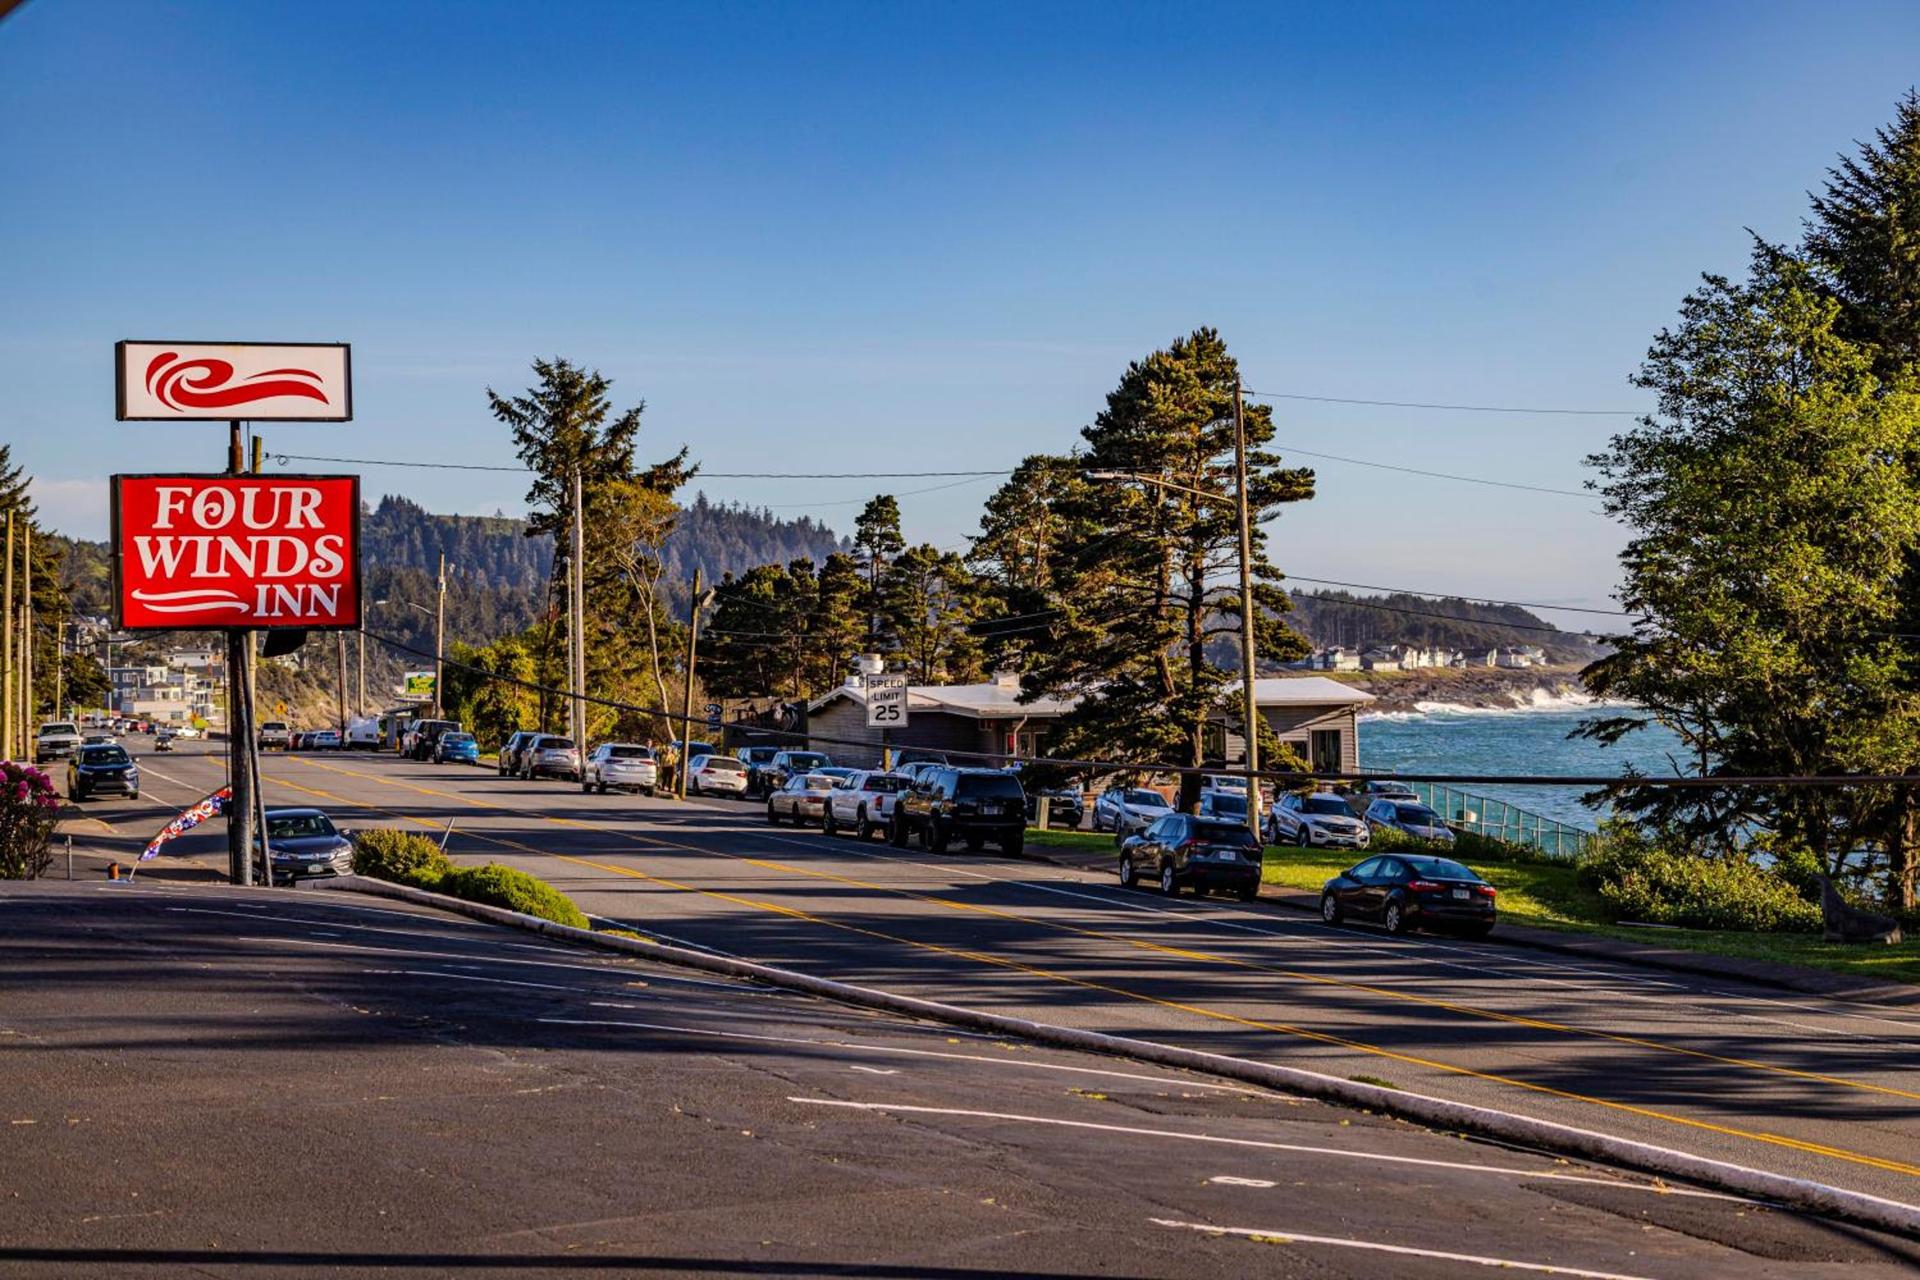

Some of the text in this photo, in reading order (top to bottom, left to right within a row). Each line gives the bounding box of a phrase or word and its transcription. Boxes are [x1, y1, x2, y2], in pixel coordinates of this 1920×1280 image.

[152, 486, 325, 529] FOUR
[133, 534, 344, 579] WINDS
[253, 584, 342, 617] INN
[870, 679, 904, 689] SPEED
[873, 692, 900, 701] LIMIT
[875, 704, 900, 721] 25
